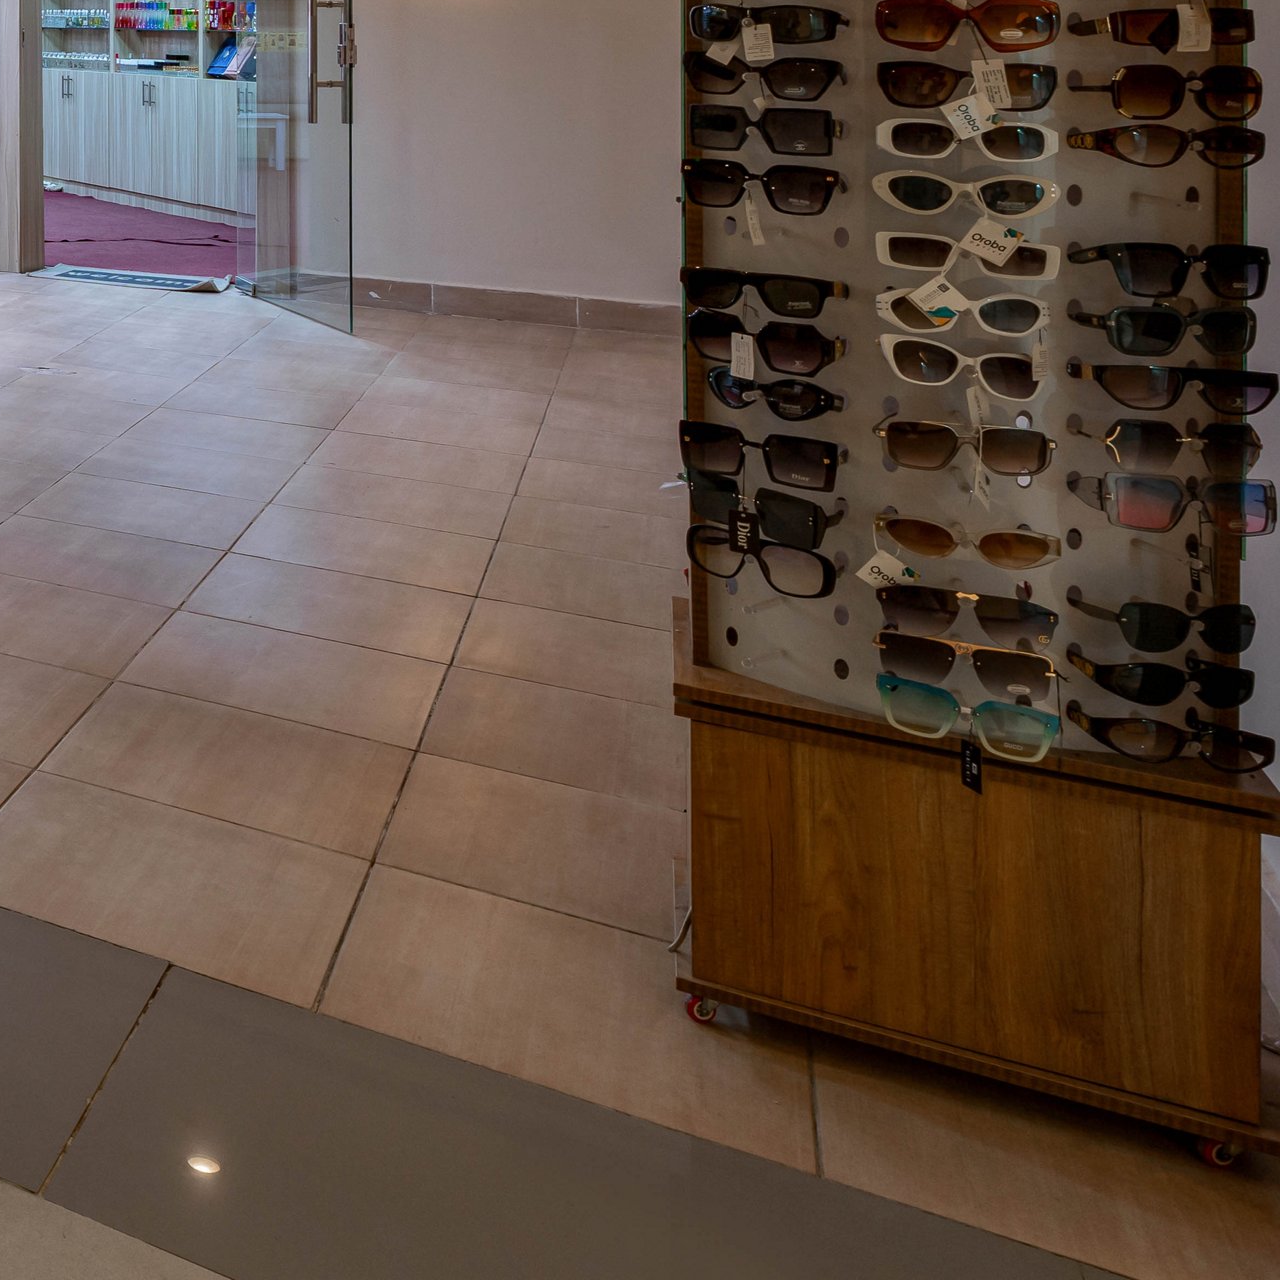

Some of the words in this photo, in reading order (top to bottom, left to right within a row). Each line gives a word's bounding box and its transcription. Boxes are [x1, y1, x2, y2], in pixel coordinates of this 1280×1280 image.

[957, 104, 980, 132] Oroba
[971, 232, 1007, 252] Oroba
[737, 521, 751, 549] Dior
[870, 565, 897, 586] Orob
